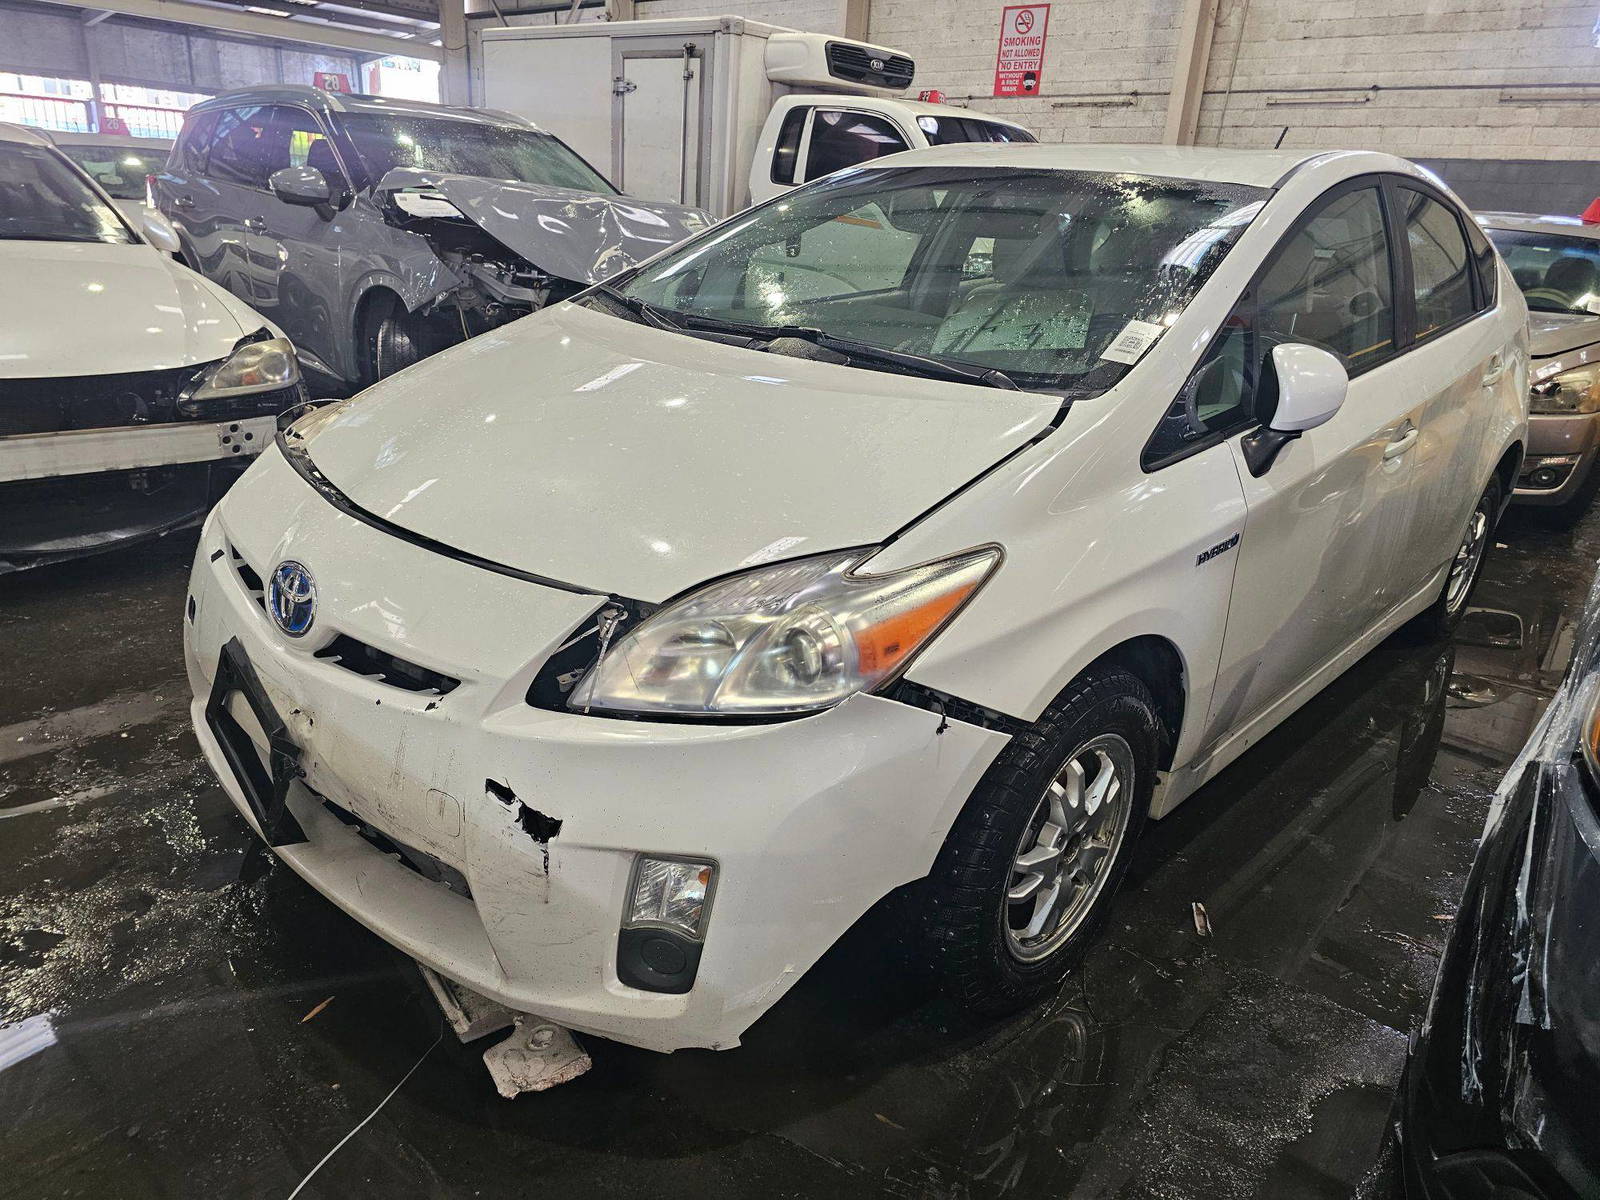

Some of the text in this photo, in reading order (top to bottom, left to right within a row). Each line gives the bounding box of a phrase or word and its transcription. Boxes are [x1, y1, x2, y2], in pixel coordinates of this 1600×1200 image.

[1003, 36, 1041, 47] SMOKING
[1001, 48, 1040, 58] NOT ALLOWED
[1000, 61, 1038, 70] NO ENTRY
[1195, 532, 1240, 567] HYBRID
